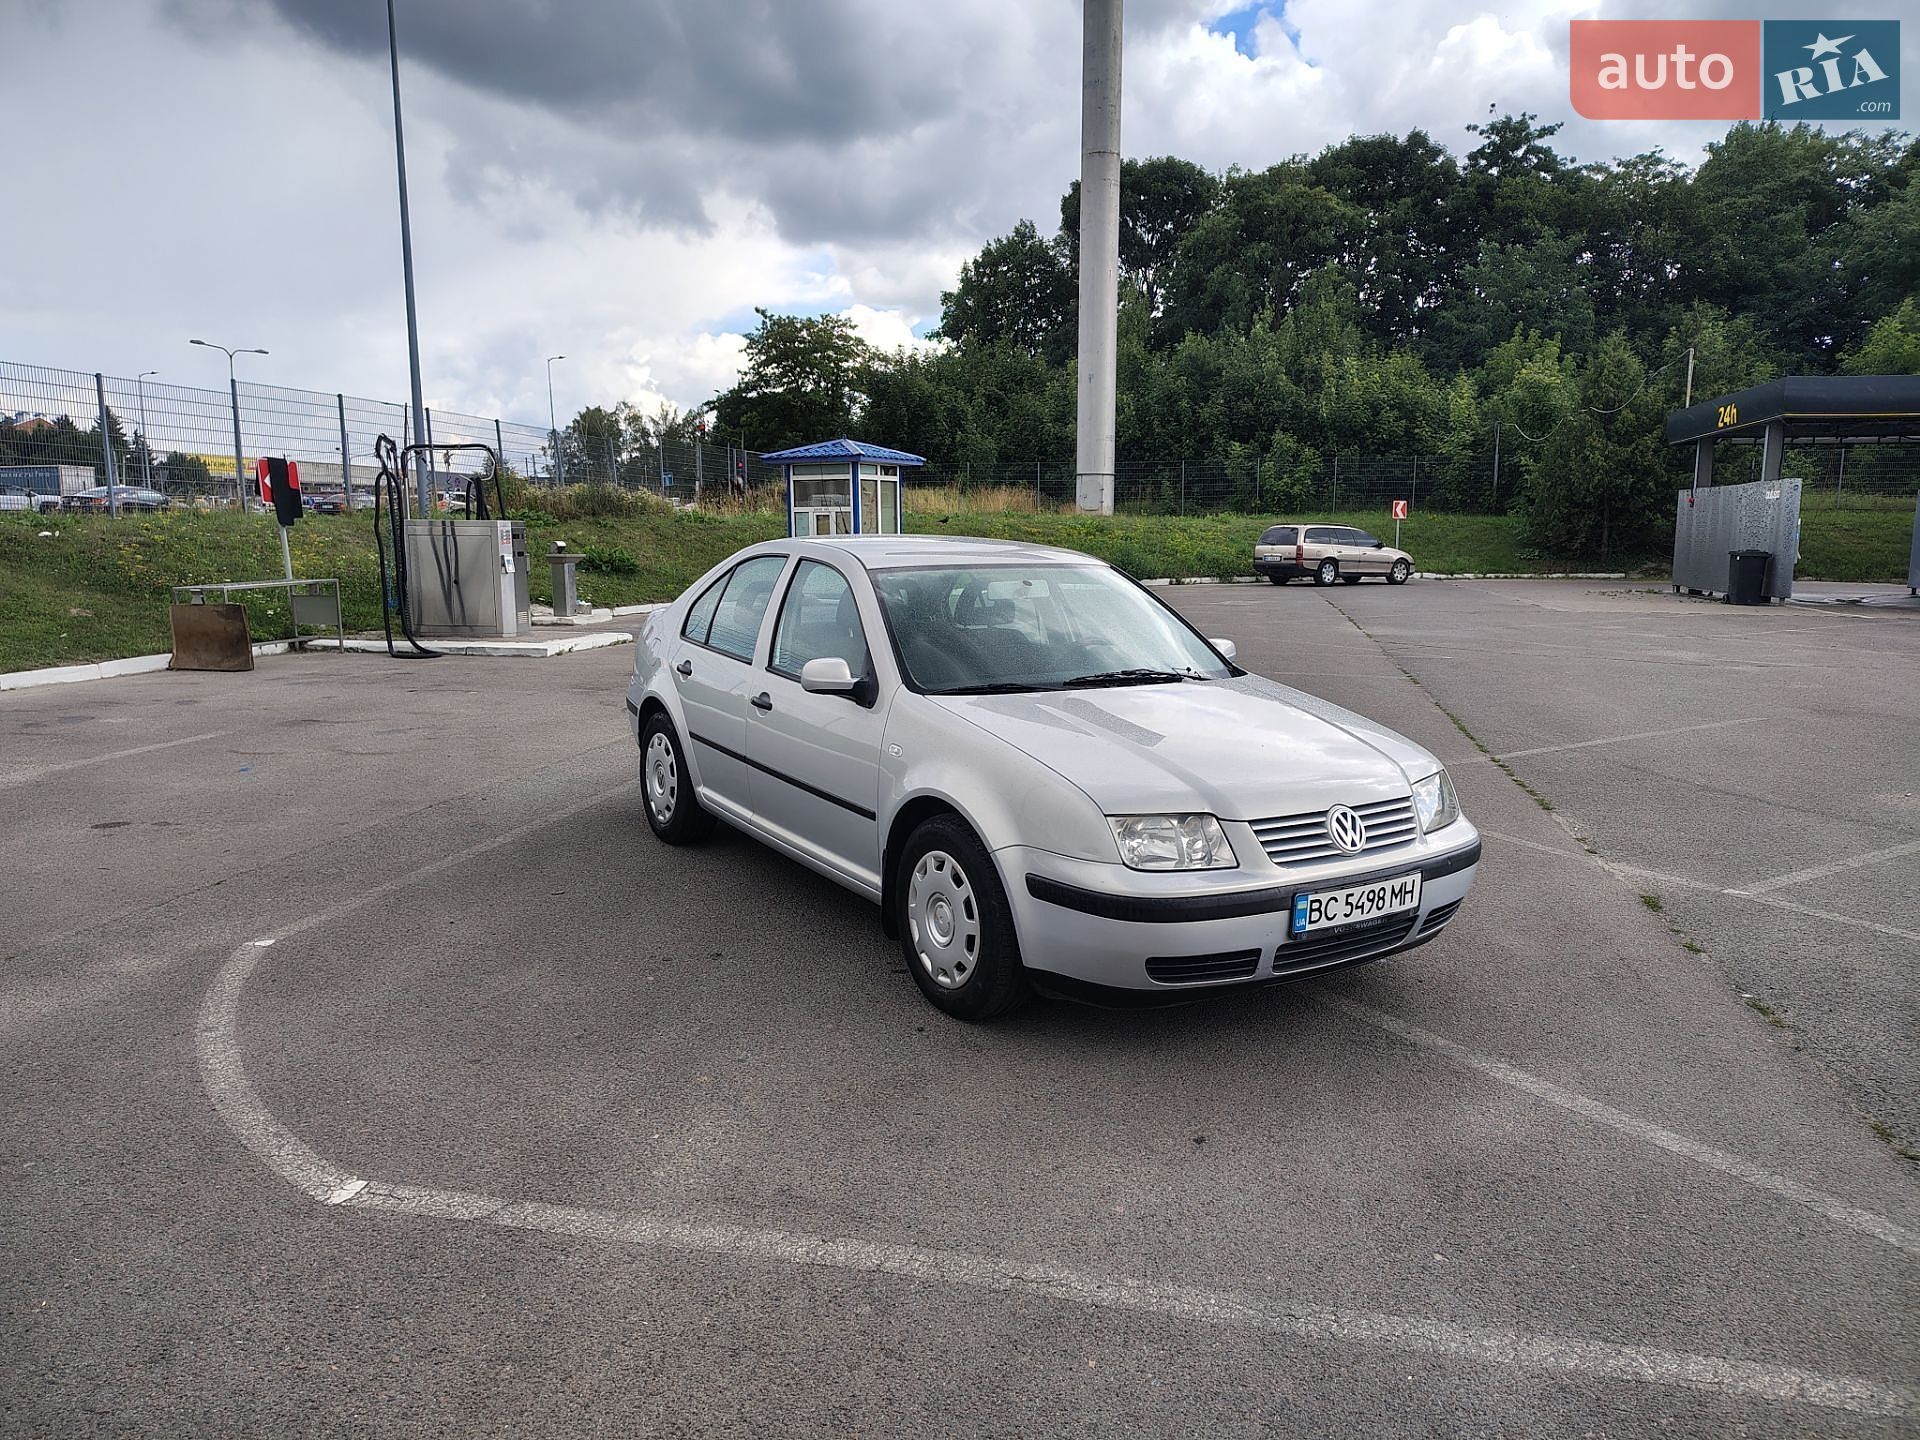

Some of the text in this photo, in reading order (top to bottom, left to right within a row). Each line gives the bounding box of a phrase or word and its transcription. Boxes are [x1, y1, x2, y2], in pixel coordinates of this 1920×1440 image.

[1717, 403, 1737, 427] 24h
[1308, 879, 1415, 924] BC 5498 MH
[1296, 918, 1305, 926] UA
